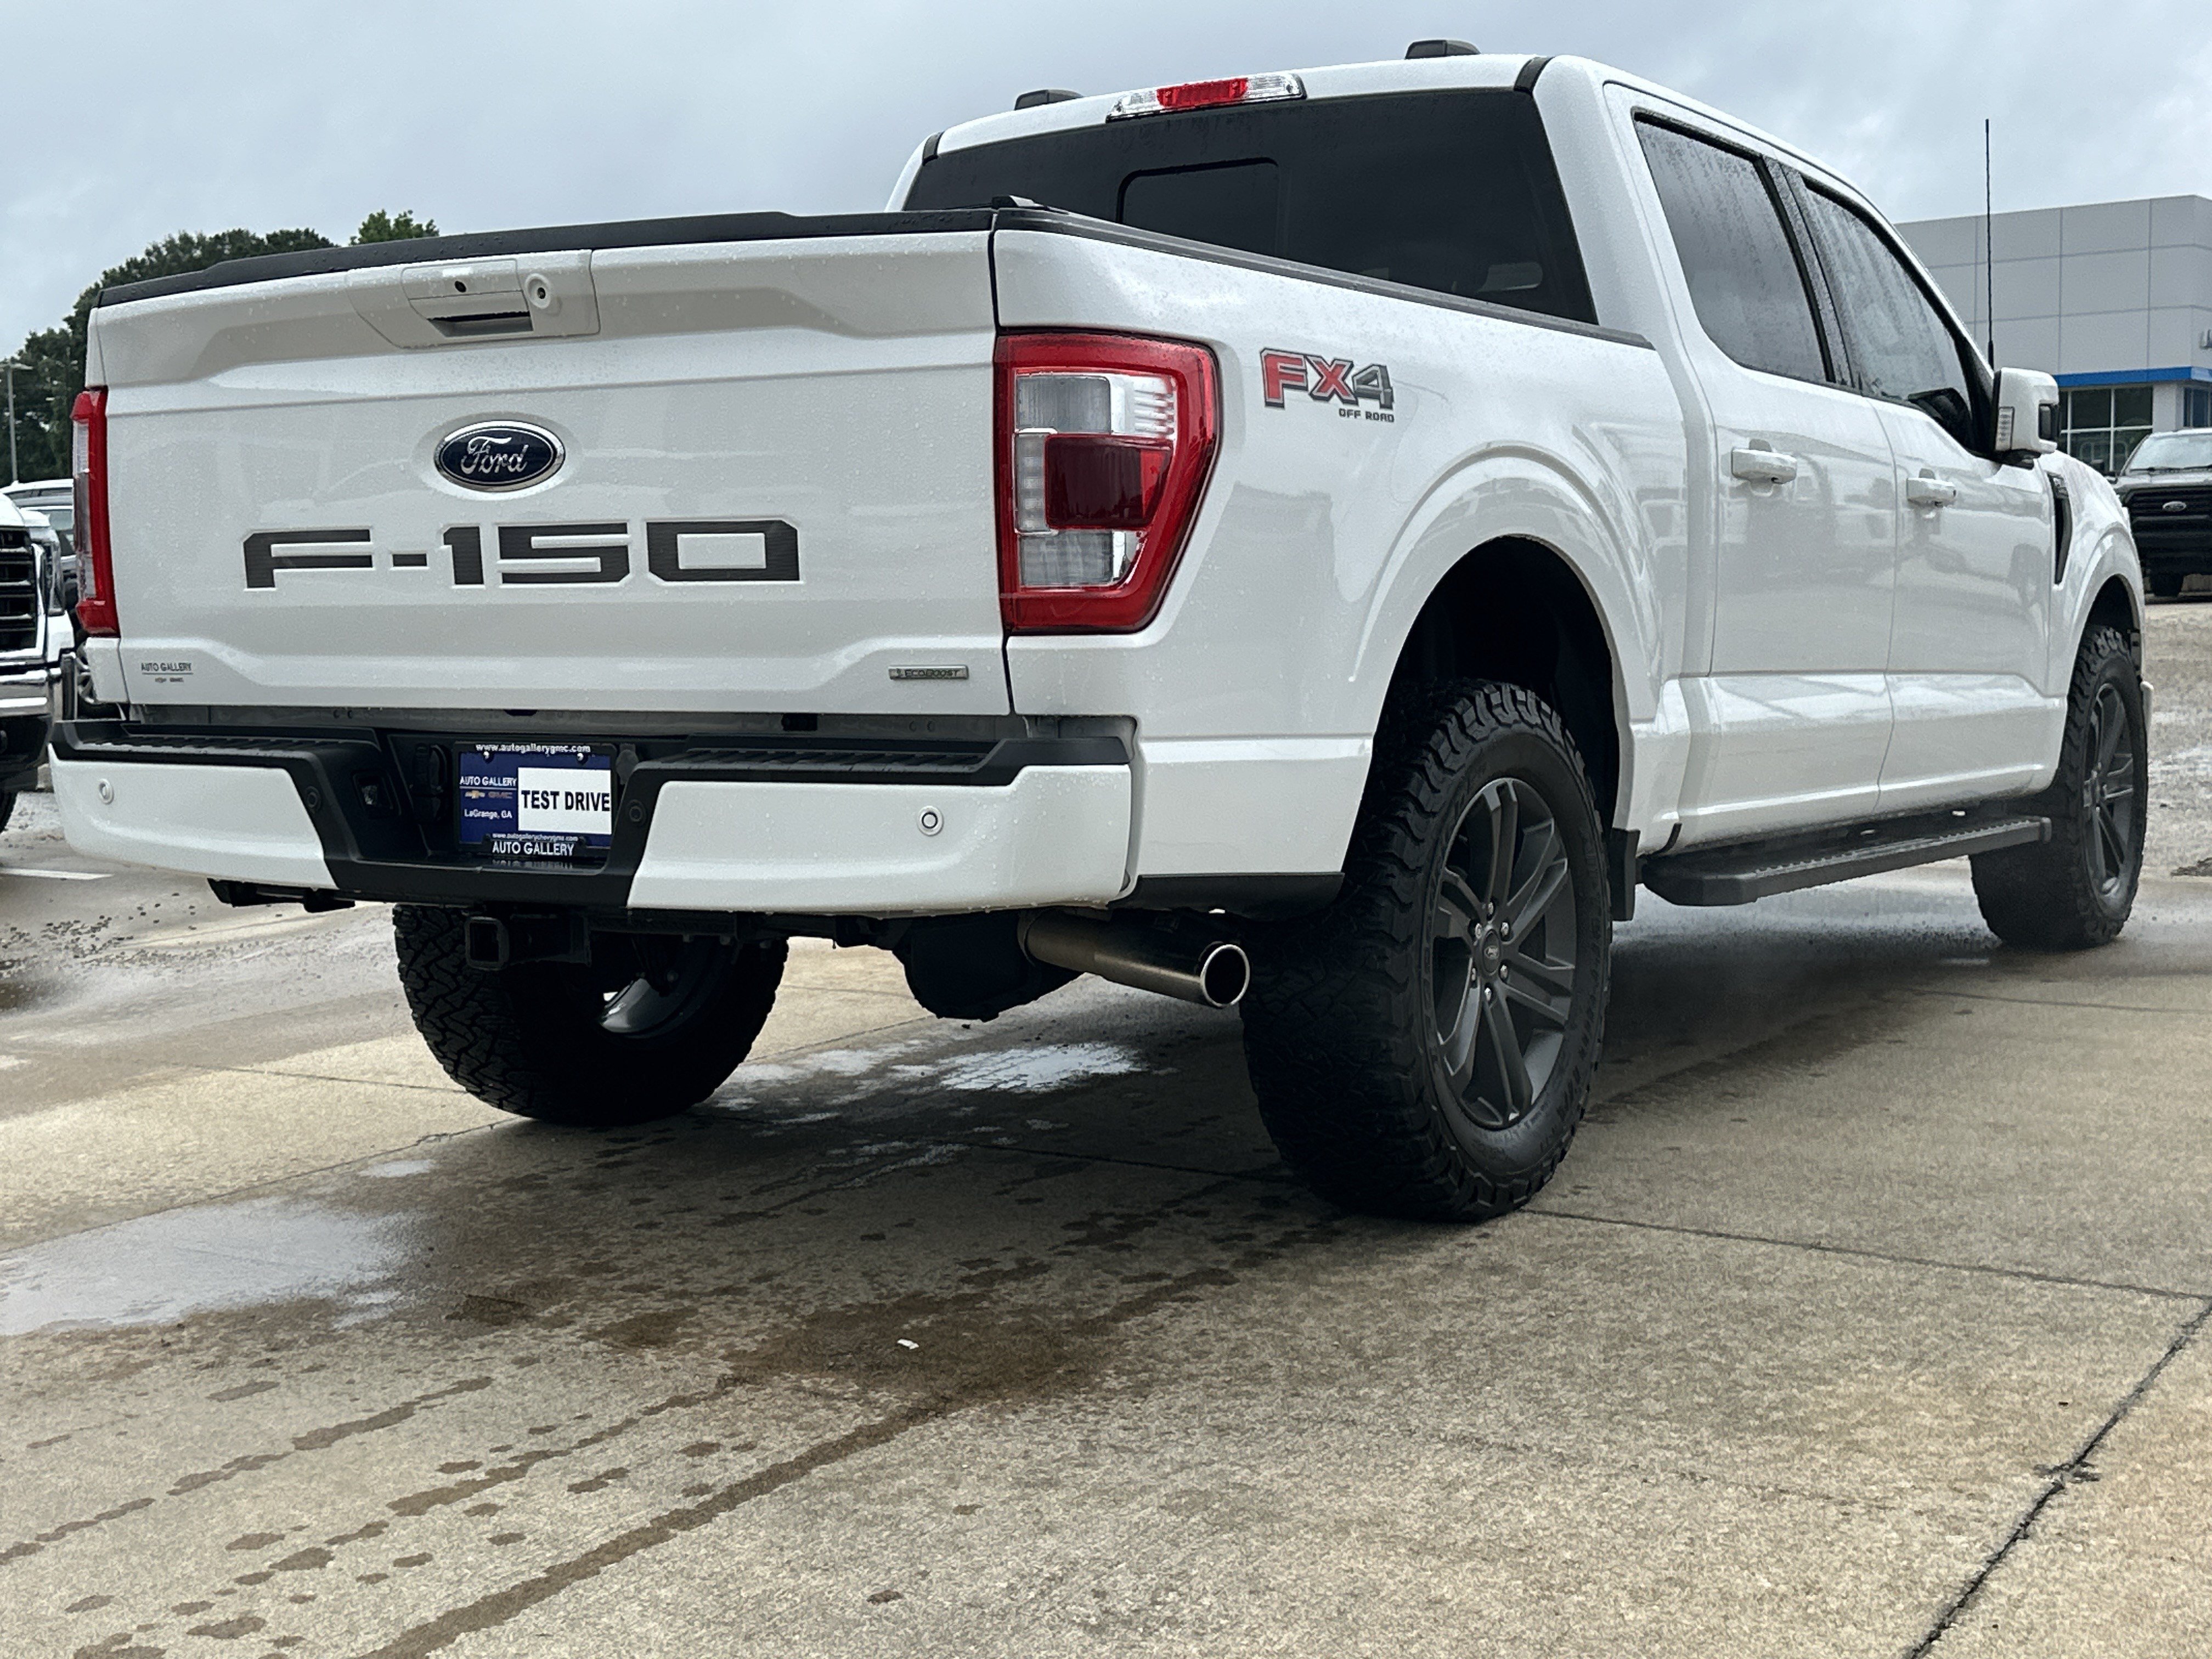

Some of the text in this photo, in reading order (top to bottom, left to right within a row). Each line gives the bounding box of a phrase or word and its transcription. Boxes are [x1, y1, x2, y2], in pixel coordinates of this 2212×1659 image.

[1260, 347, 1394, 410] FX4
[1339, 408, 1395, 422] OFF ROAD
[461, 436, 529, 474] Ford
[243, 520, 799, 588] F-150
[141, 662, 192, 672] AUTO GALLERY
[459, 776, 517, 787] AUTO GALLERY
[521, 789, 611, 811] TEST DRIVE
[493, 840, 575, 856] AUTO GALLERY
